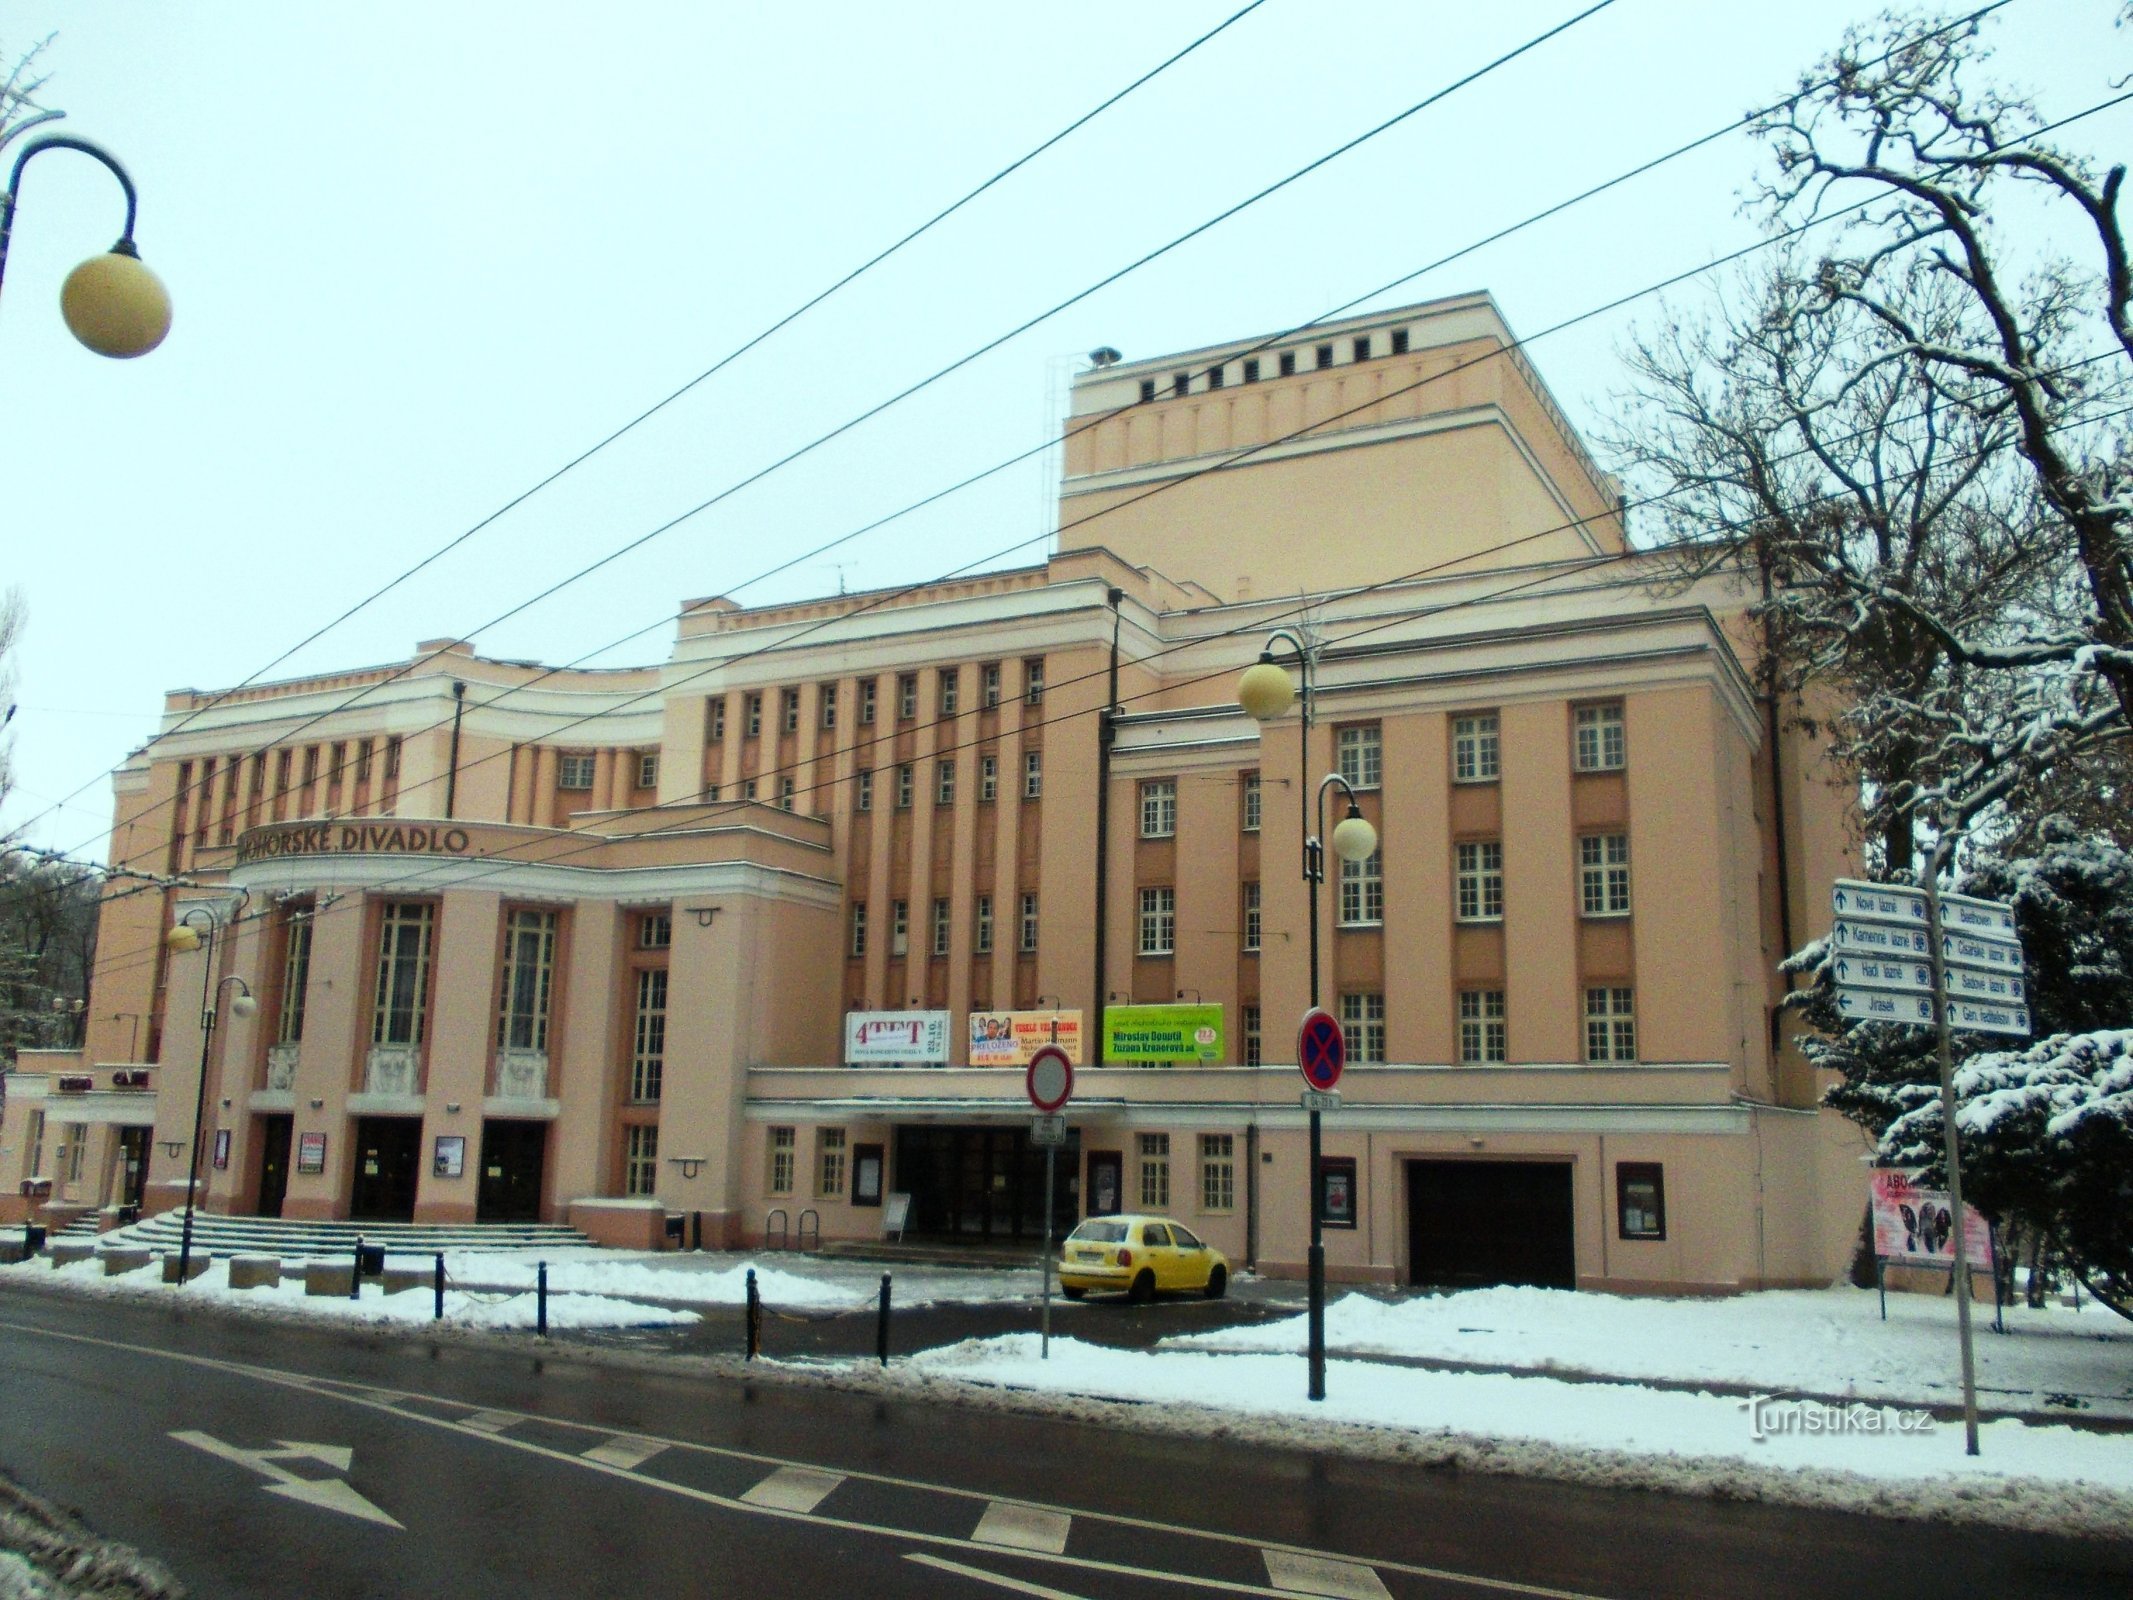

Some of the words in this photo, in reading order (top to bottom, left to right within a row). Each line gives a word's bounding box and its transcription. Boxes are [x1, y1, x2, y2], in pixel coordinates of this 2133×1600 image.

[341, 825, 470, 853] DIVADLO
[1856, 894, 1875, 911] Nové
[1960, 908, 1992, 927] Beethoven
[1021, 1037, 1044, 1045] Martin
[1113, 1031, 1150, 1041] Miroslav
[1151, 1031, 1182, 1041] Donutil
[1113, 1043, 1141, 1053] Zuzana
